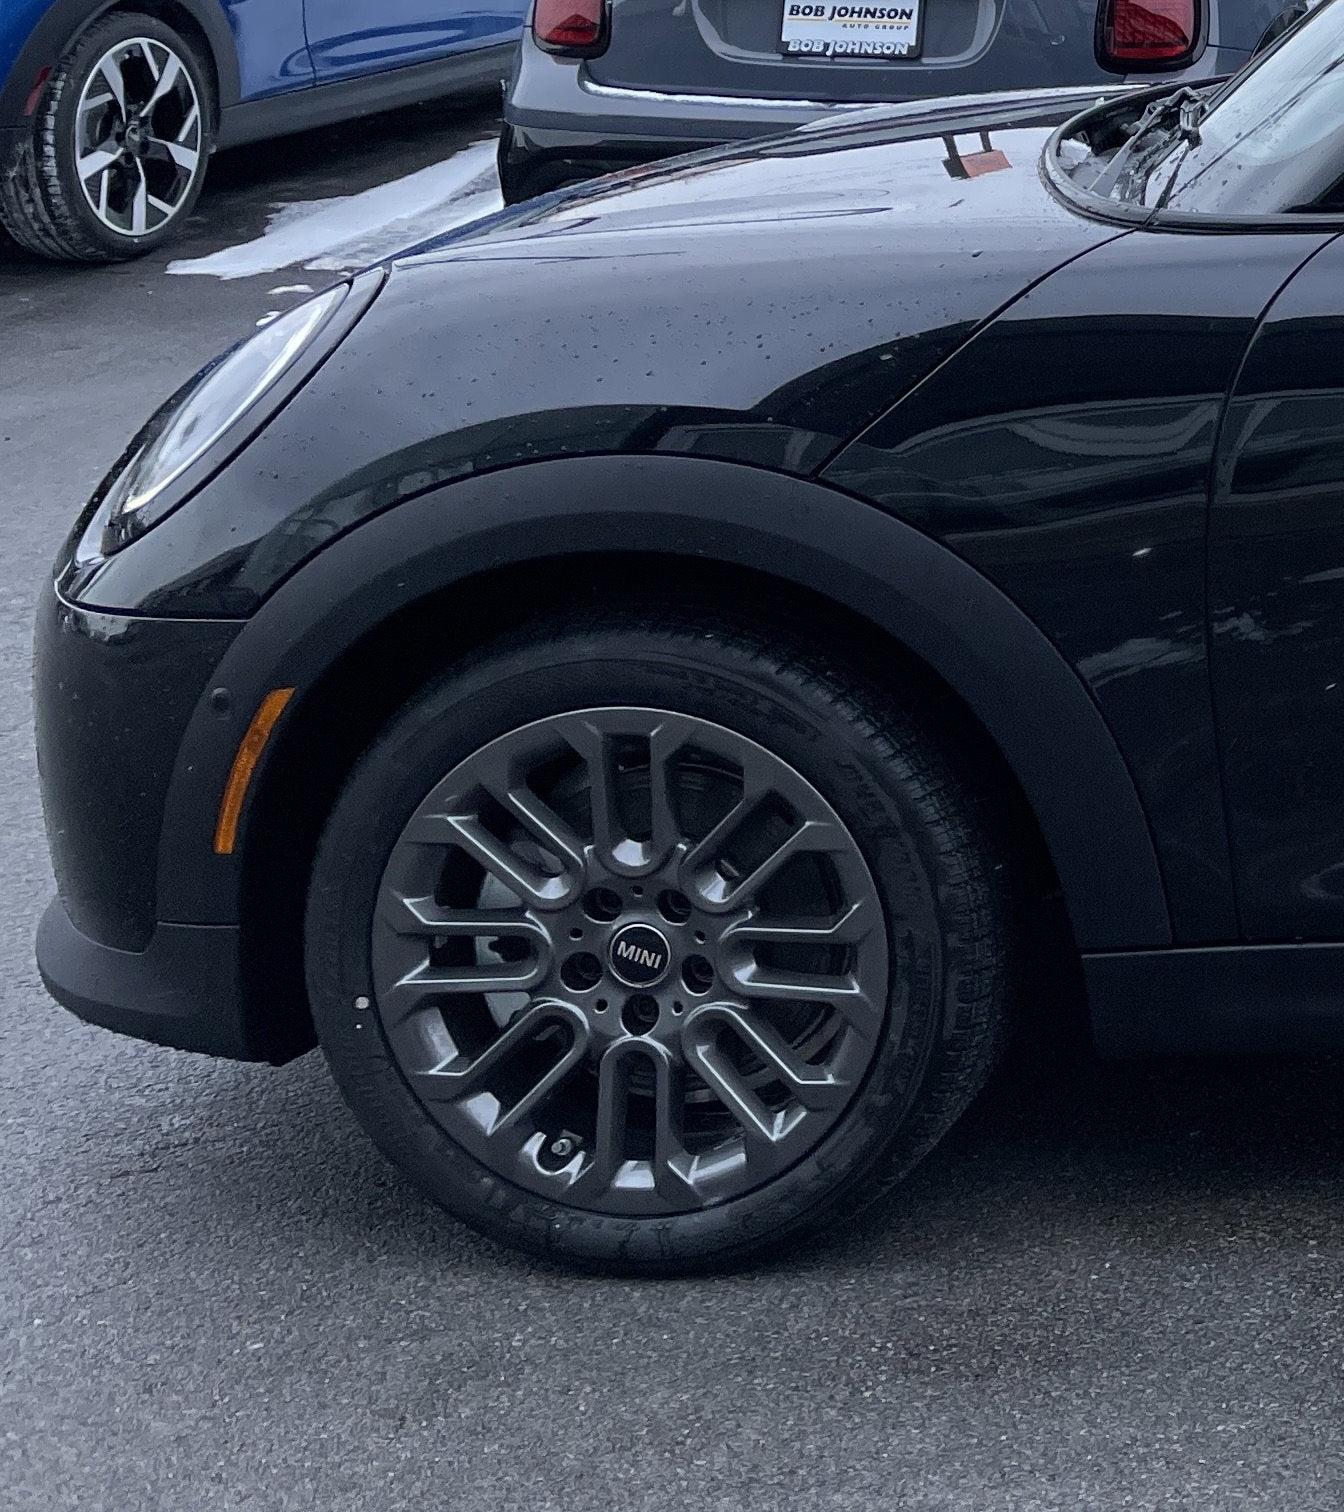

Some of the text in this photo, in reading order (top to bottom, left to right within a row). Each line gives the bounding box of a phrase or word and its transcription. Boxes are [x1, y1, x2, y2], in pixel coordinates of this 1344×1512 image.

[788, 4, 914, 21] BOB JOHNSON
[787, 38, 910, 56] BOB JOHNSON
[616, 940, 662, 970] MINI
